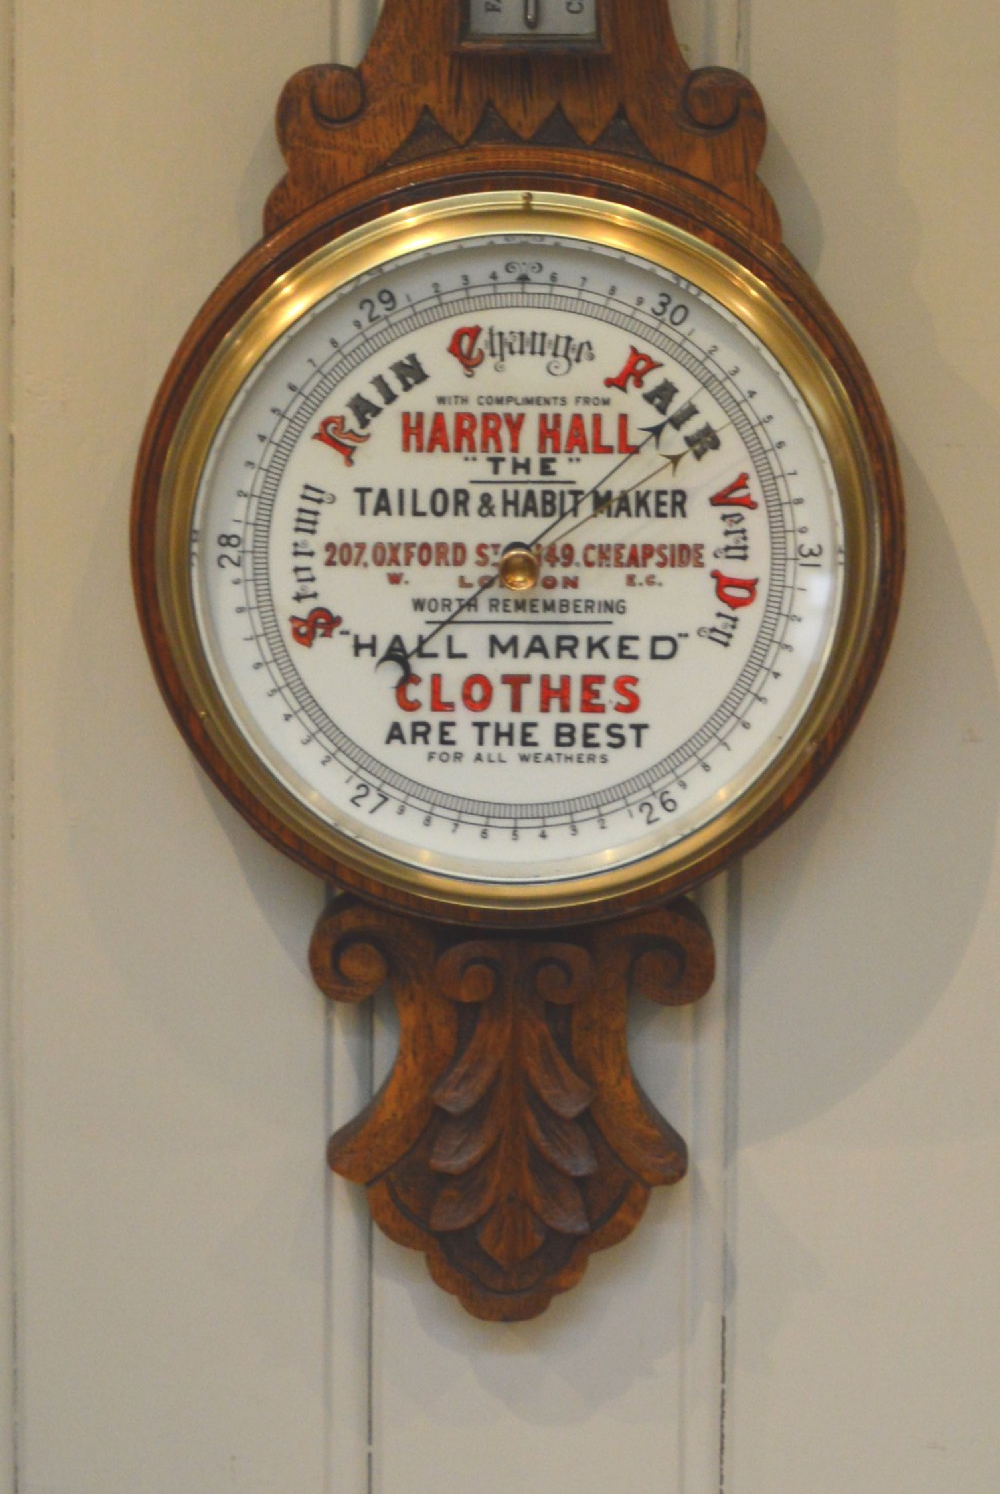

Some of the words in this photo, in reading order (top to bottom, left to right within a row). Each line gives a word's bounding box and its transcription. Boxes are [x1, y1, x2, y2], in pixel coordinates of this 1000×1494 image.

[359, 288, 397, 323] 29
[651, 292, 690, 326] 30
[447, 324, 595, 377] Change
[311, 353, 429, 467] RAIN
[436, 396, 468, 405] WITH
[477, 396, 567, 406] COMPLIMENTS
[575, 396, 610, 406] FROM
[603, 345, 720, 461] FAIR
[401, 411, 525, 453] HARRY
[538, 412, 640, 454] HALL
[353, 487, 470, 517] TAILOR
[477, 492, 496, 518] &
[501, 488, 584, 518] HABIT
[592, 489, 688, 519] MAKER
[217, 533, 242, 569] 28
[798, 544, 823, 567] 31
[458, 575, 579, 589] LOON
[412, 597, 478, 613] WORTH
[488, 598, 627, 615] REMEMBERING
[395, 673, 641, 714] CLOTHES
[384, 721, 456, 746] ARE
[471, 721, 539, 747] THE
[554, 722, 650, 749] BEST
[426, 751, 464, 764] FOR
[473, 752, 507, 764] ALL
[518, 752, 609, 764] WEATHERS
[350, 783, 389, 814] 27
[639, 790, 678, 825] 26
